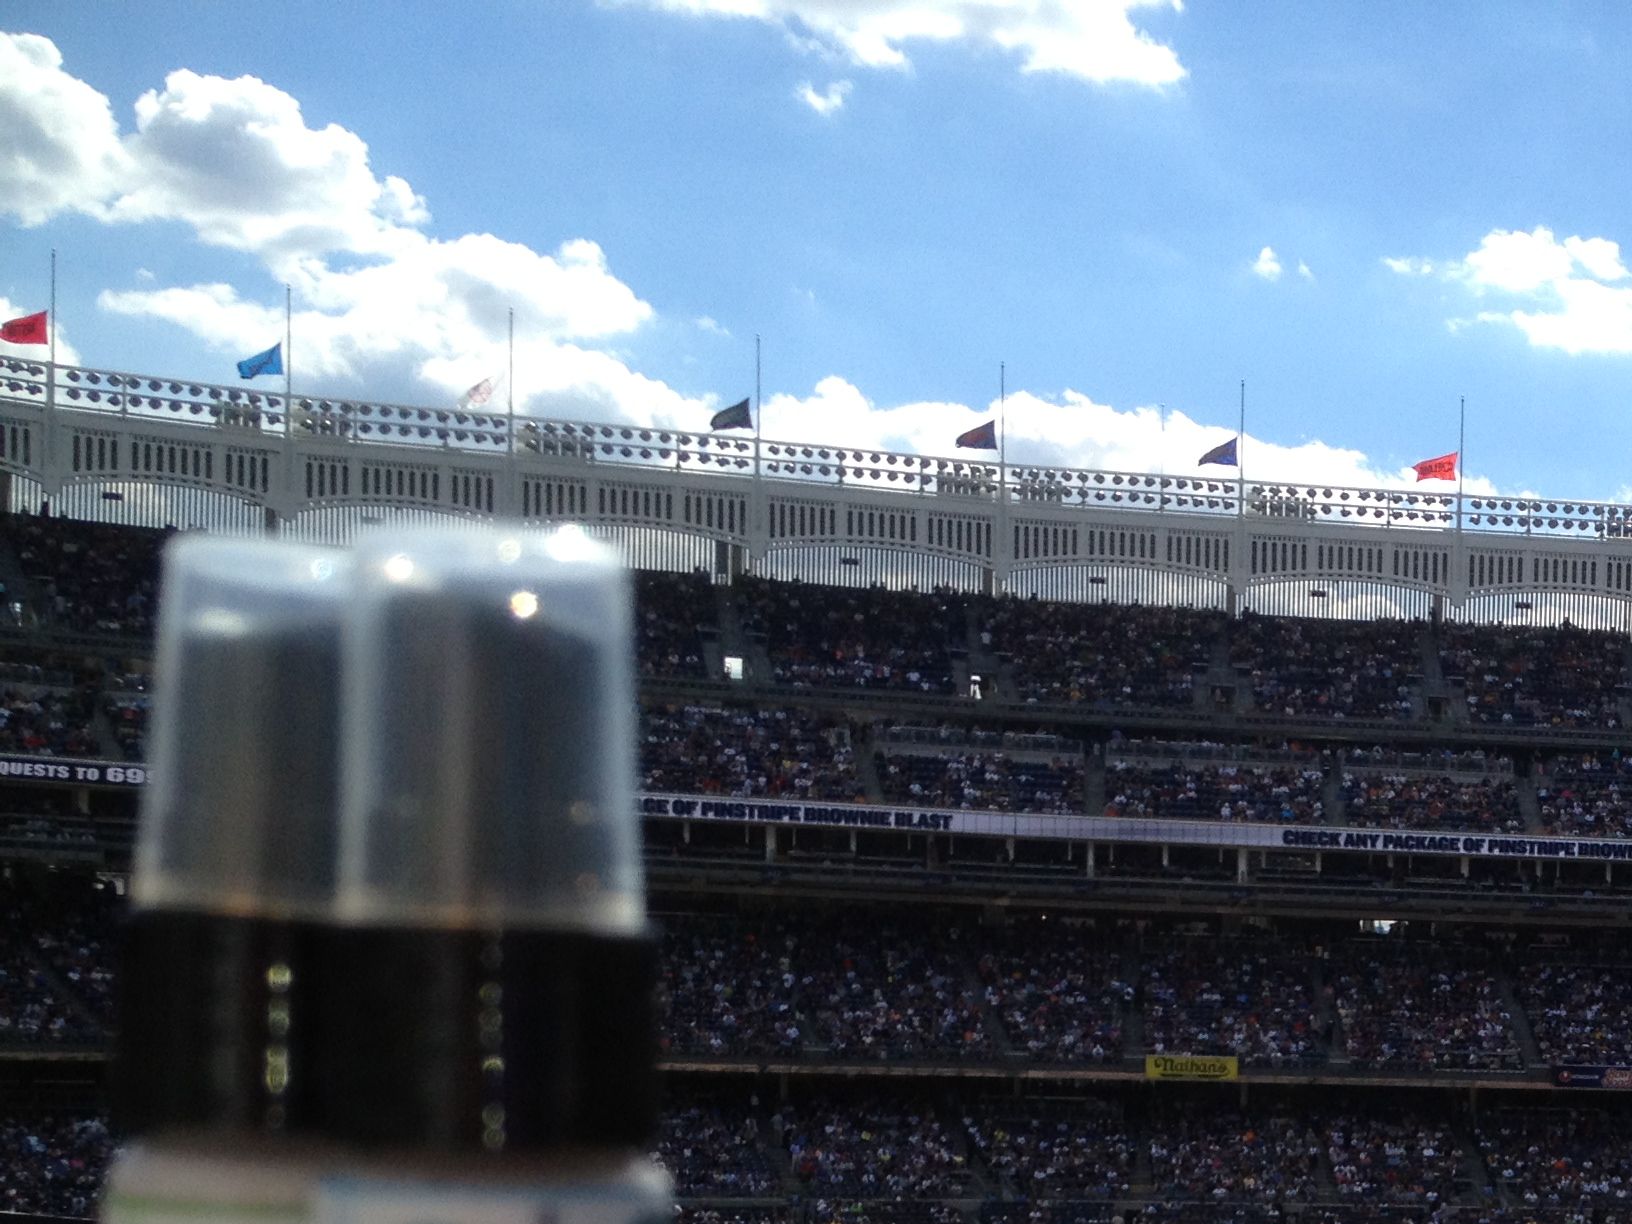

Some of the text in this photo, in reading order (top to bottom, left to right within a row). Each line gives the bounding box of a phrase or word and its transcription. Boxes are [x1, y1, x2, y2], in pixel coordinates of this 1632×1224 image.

[76, 767, 99, 780] TO
[672, 799, 699, 816] OF
[701, 801, 801, 821] PINSTRIPE
[804, 806, 891, 825] BROWNIE
[894, 811, 953, 829] BLAST
[1283, 830, 1341, 847] CHECK
[1343, 832, 1380, 849] ANY
[1382, 834, 1460, 851] PACKAGE
[1462, 837, 1486, 852] OF
[1488, 839, 1576, 856] PINSTRIPE
[1154, 1057, 1229, 1073] Nathan's
